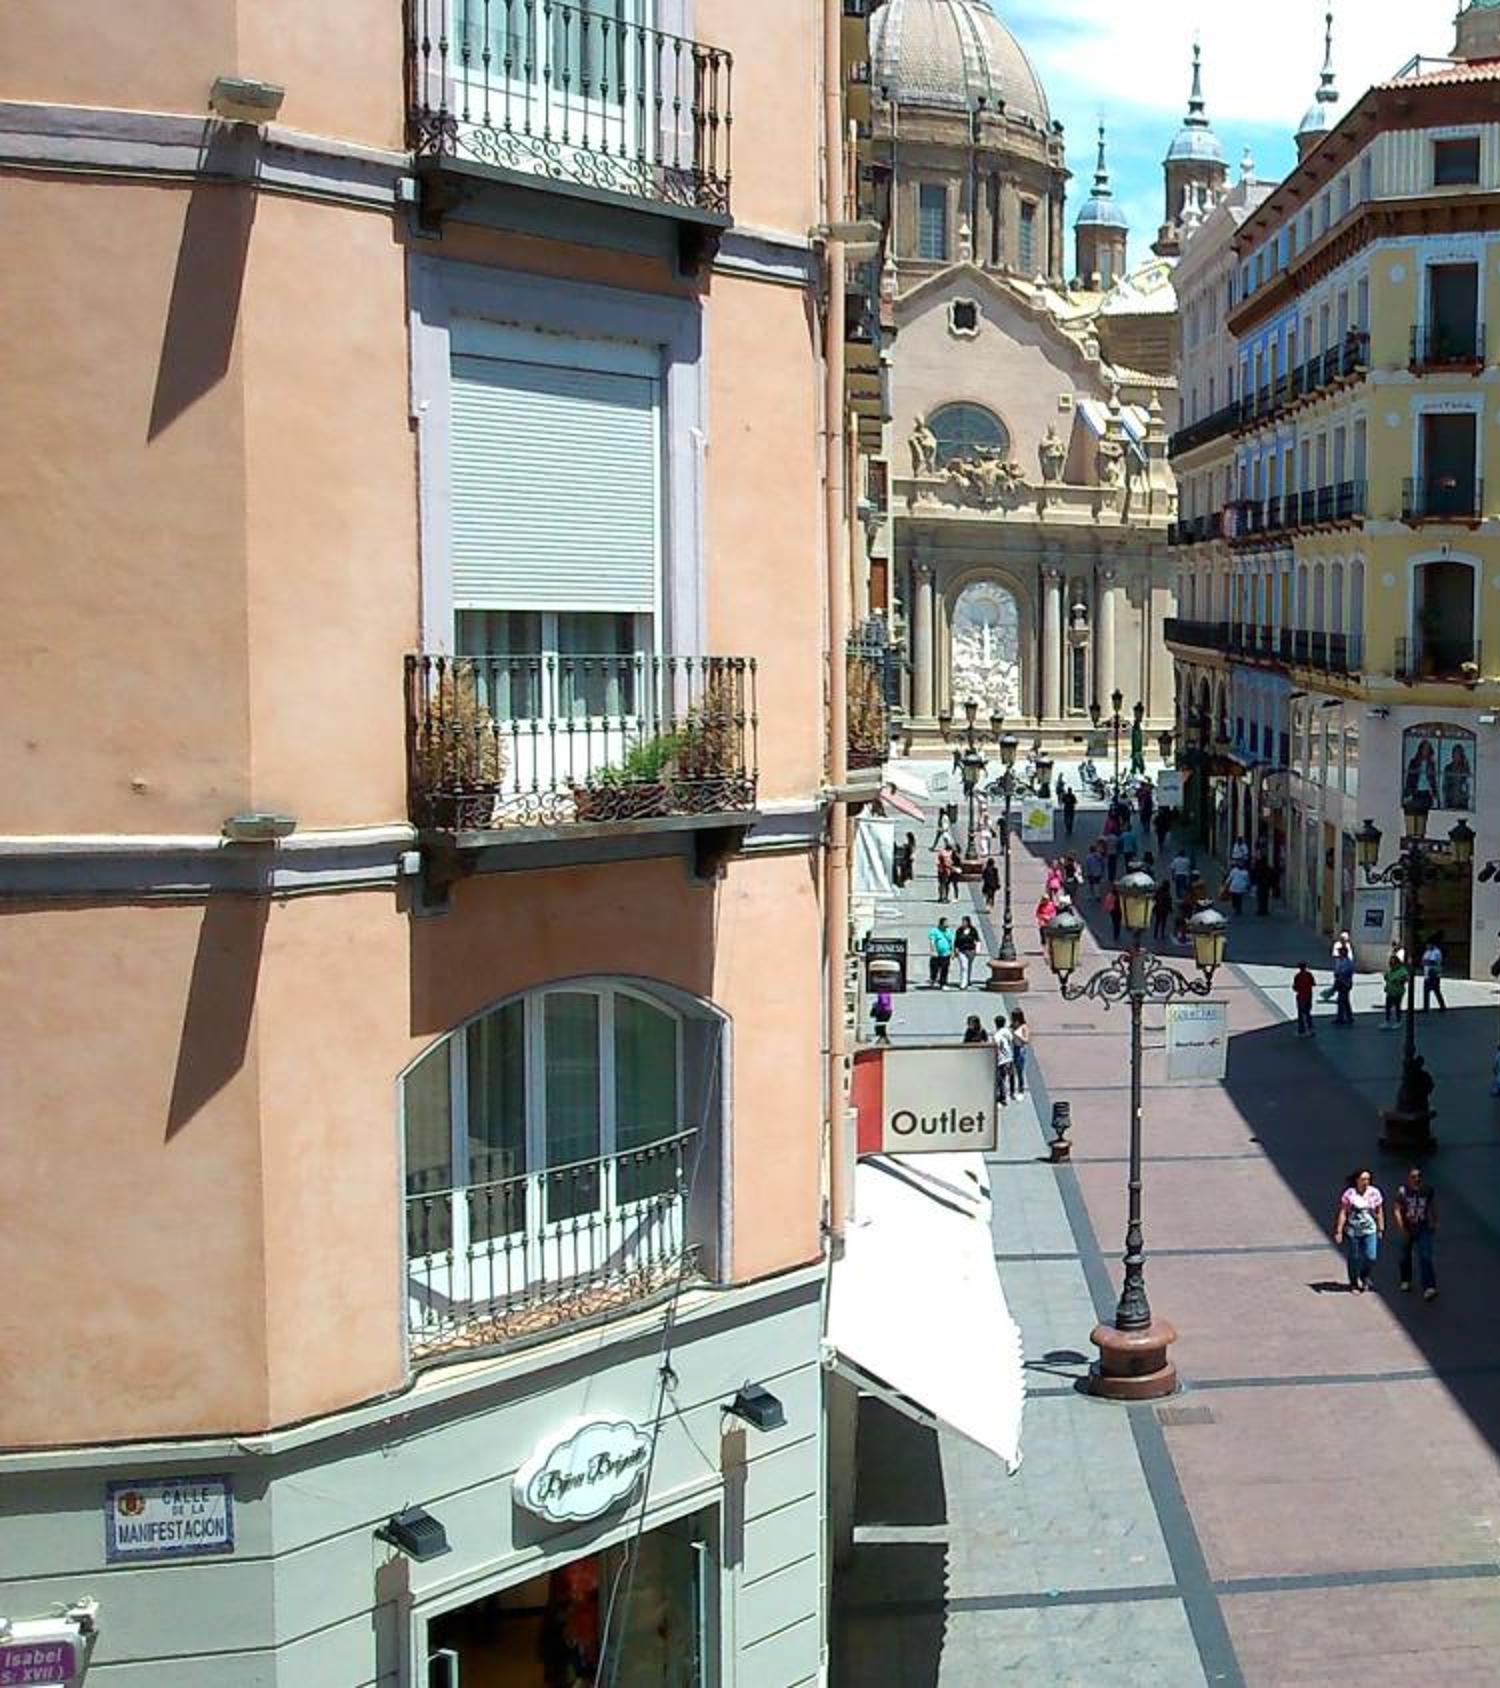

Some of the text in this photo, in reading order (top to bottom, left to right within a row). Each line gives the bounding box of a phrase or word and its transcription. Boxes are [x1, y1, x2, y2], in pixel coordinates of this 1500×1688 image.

[891, 1108, 985, 1135] Outlet
[161, 1487, 209, 1504] CALLE
[191, 1503, 205, 1515] LA
[118, 1517, 225, 1542] MANIFESTACION
[4, 1647, 63, 1668] Isabel
